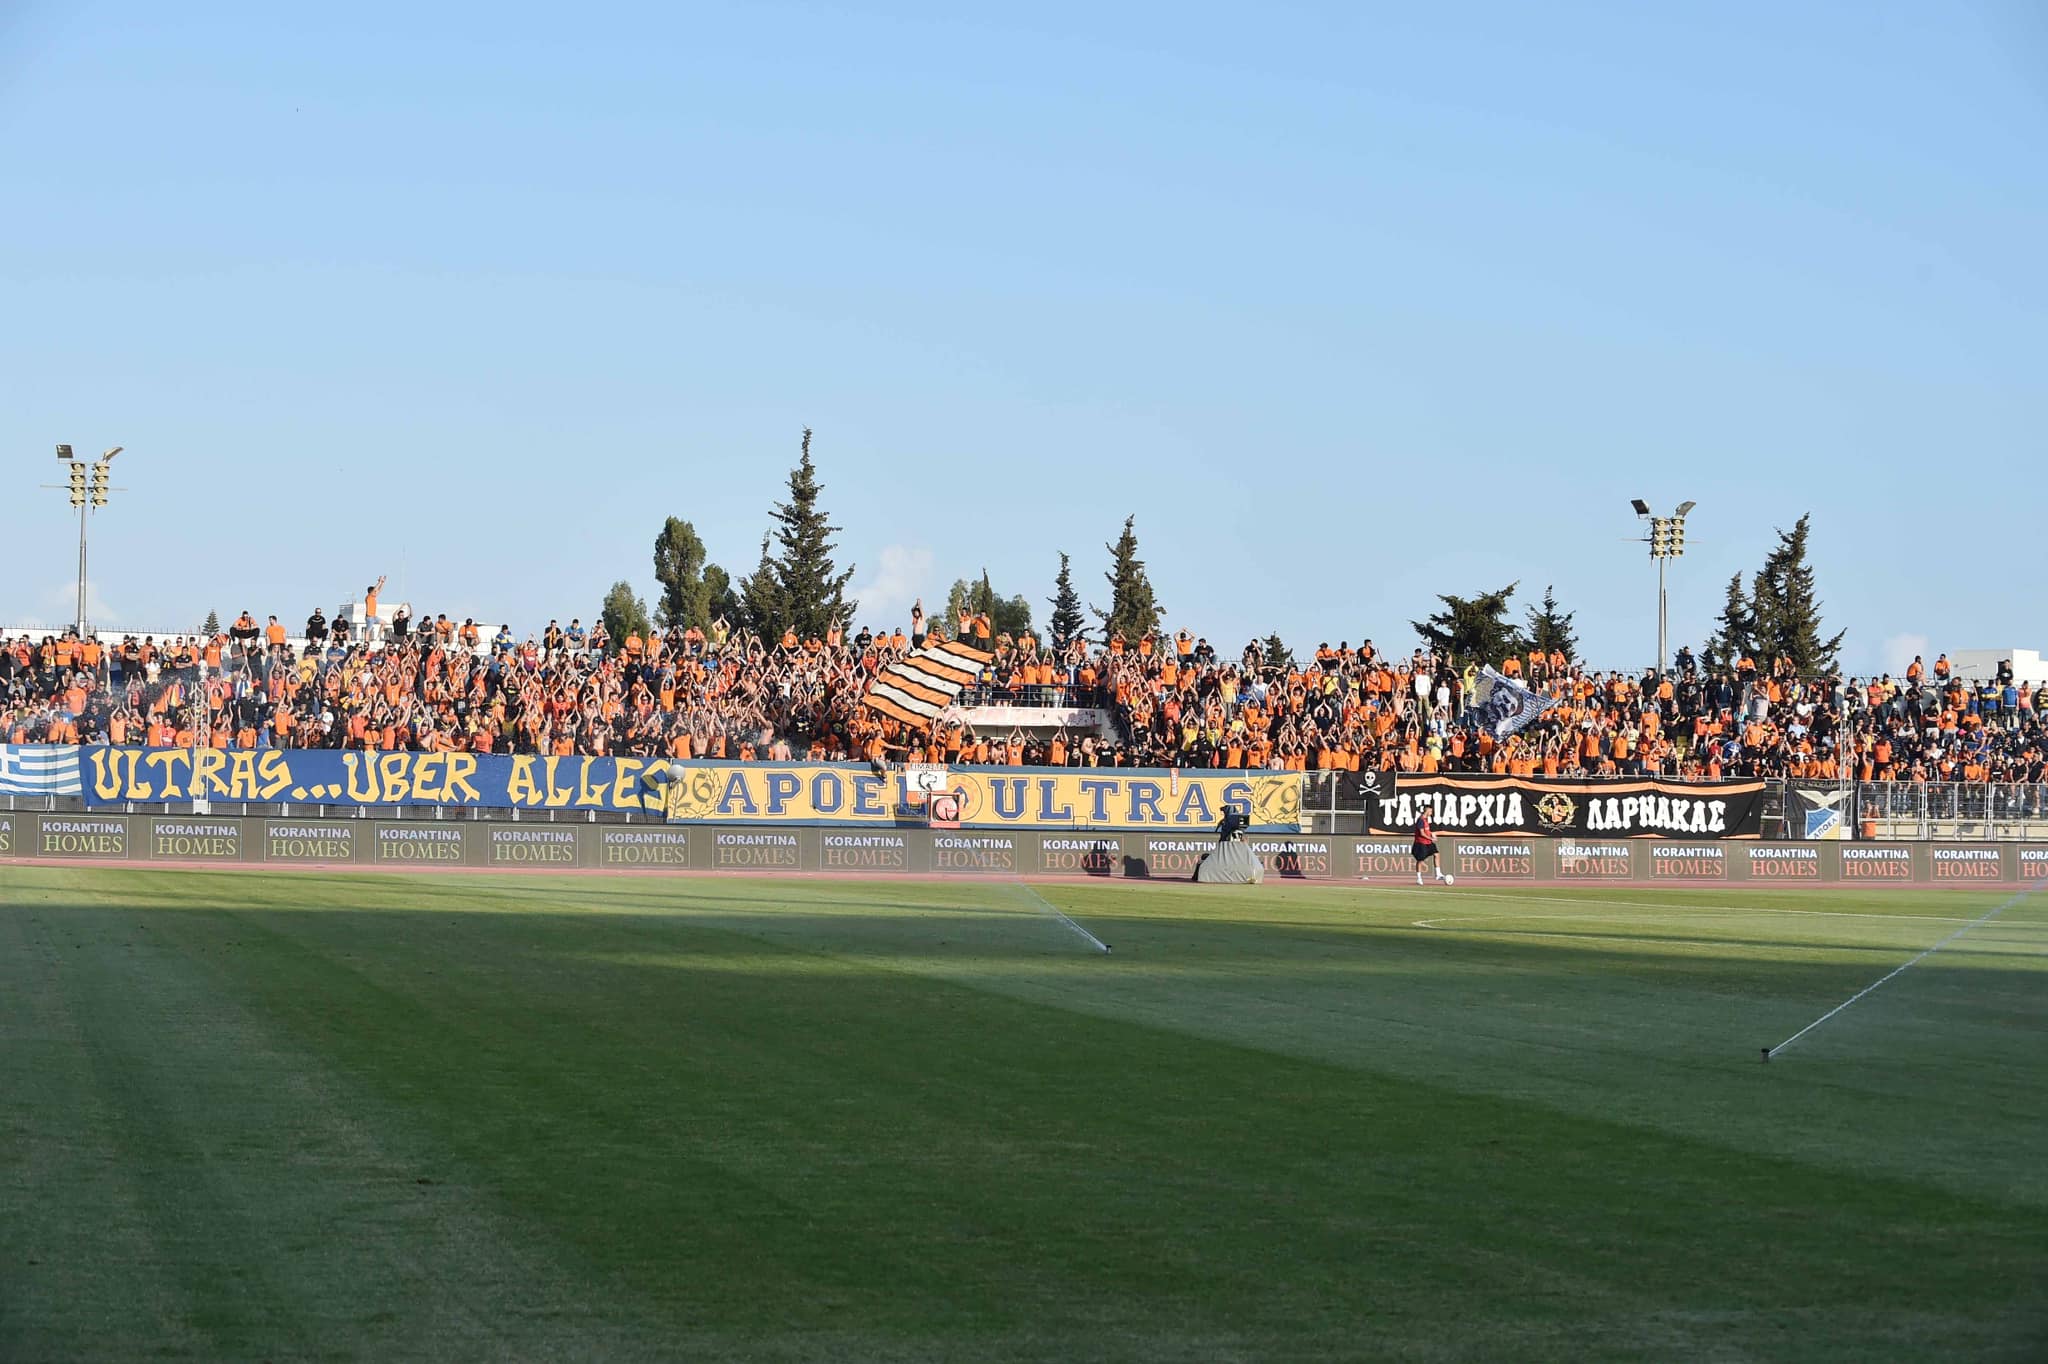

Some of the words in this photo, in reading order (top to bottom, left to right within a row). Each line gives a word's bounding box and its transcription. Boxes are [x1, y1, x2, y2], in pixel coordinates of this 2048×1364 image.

[507, 754, 670, 812] ALLES
[987, 776, 1254, 825] ULTRAS
[42, 822, 124, 833] KORANTINA
[155, 824, 237, 836] KORANTINA
[269, 827, 351, 839] KORANTINA
[380, 829, 461, 841] KORANTINA
[493, 831, 574, 842] KORANTINA
[605, 833, 685, 844] KORANTINA
[717, 834, 797, 846] KORANTINA
[824, 836, 904, 847] KORANTINA
[44, 834, 122, 852] HOMES
[157, 837, 236, 855] HOMES
[271, 839, 350, 858] HOMES
[934, 838, 1013, 849] KORANTINA
[1043, 840, 1119, 850] KORANTINA
[1149, 841, 1217, 851] KORANTIN
[1252, 842, 1327, 853] KORANTINA
[1356, 844, 1412, 854] KORANTI
[1458, 845, 1531, 855] KORANTINA
[382, 842, 460, 860] HOMES
[495, 844, 573, 862] HOMES
[607, 845, 685, 864] HOMES
[720, 847, 796, 865] HOMES
[827, 849, 903, 867] HOMES
[1558, 846, 1629, 857] KORANTINA
[1653, 847, 1723, 857] KORANTINA
[1749, 848, 1817, 859] KORANTINA
[1843, 849, 1909, 859] KORANTINA
[1934, 850, 1999, 859] KORANTINA
[936, 851, 1012, 869] HOMES
[1045, 852, 1119, 869] HOMES
[1151, 853, 1200, 870] HOM
[1461, 857, 1530, 874] HOMES
[1561, 858, 1629, 875] HOMES
[1656, 859, 1722, 875] HOMES
[1752, 860, 1817, 876] HOMES
[1845, 861, 1909, 877] HOMES
[1936, 861, 1999, 877] HOMES
